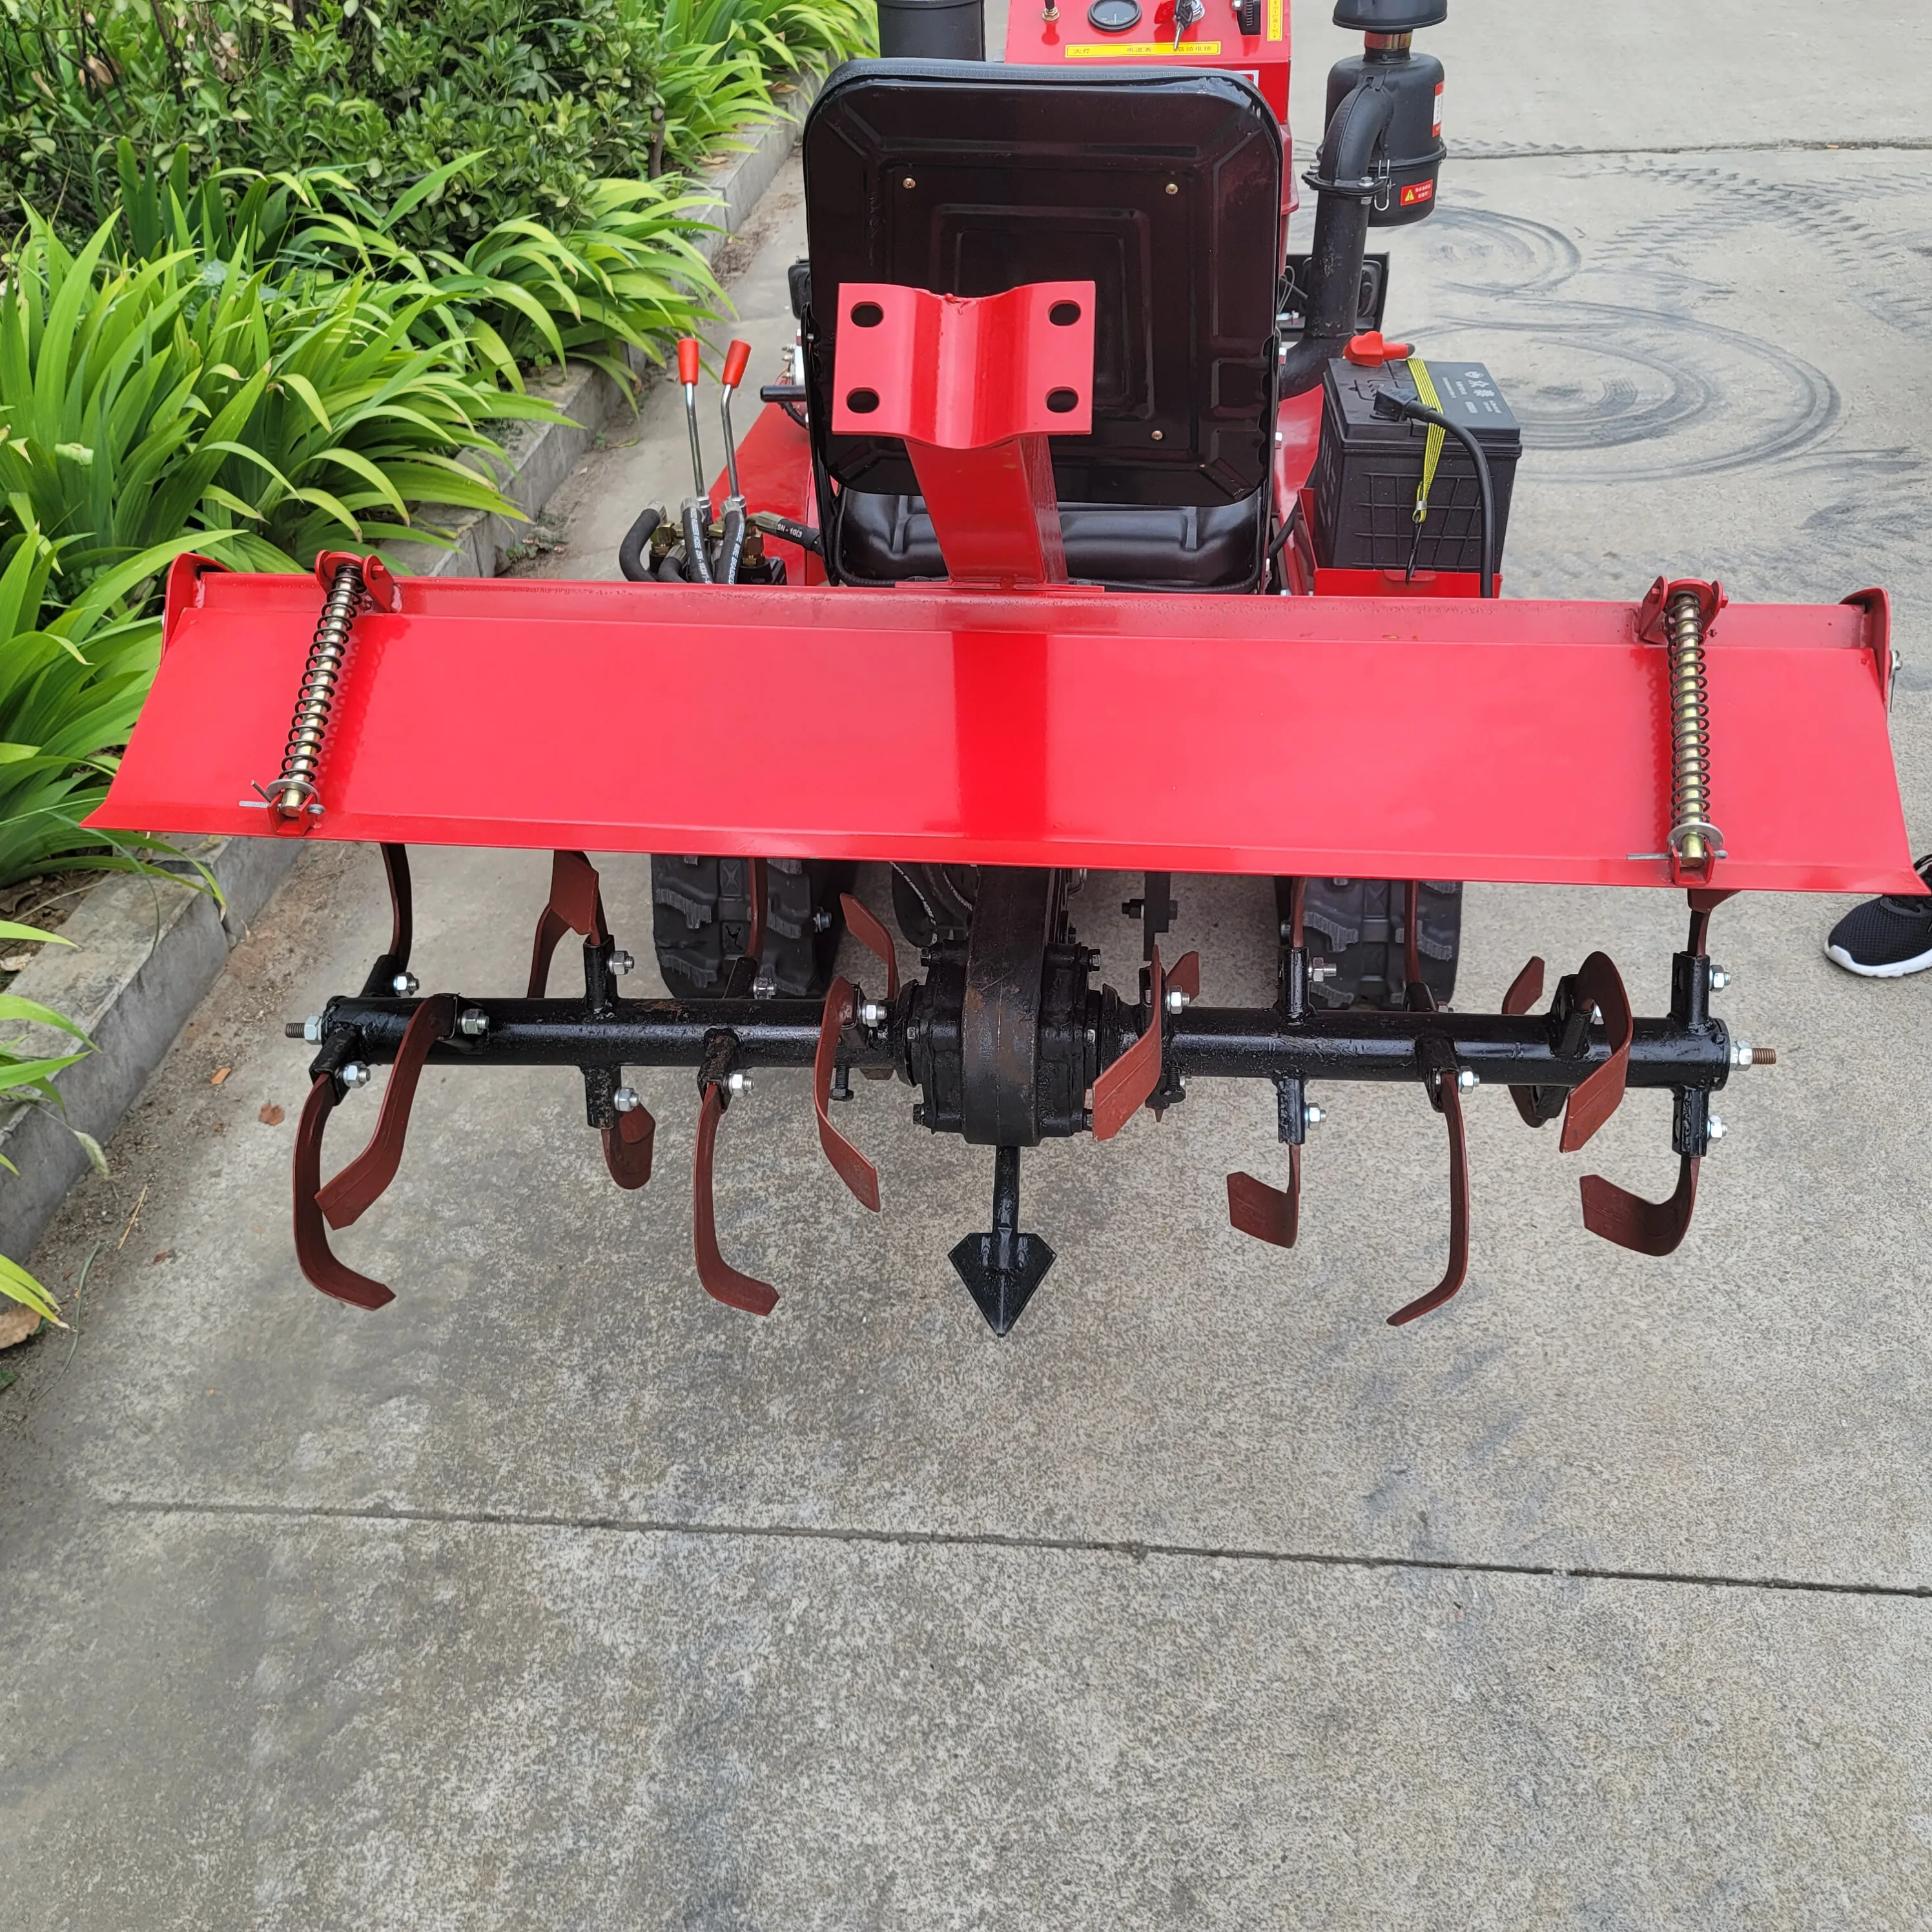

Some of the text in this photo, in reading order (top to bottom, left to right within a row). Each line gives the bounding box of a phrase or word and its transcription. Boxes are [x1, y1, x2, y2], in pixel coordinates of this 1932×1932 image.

[694, 535, 702, 550] HOSE
[732, 542, 741, 559] WIRE
[728, 556, 738, 585] BRAIDED
